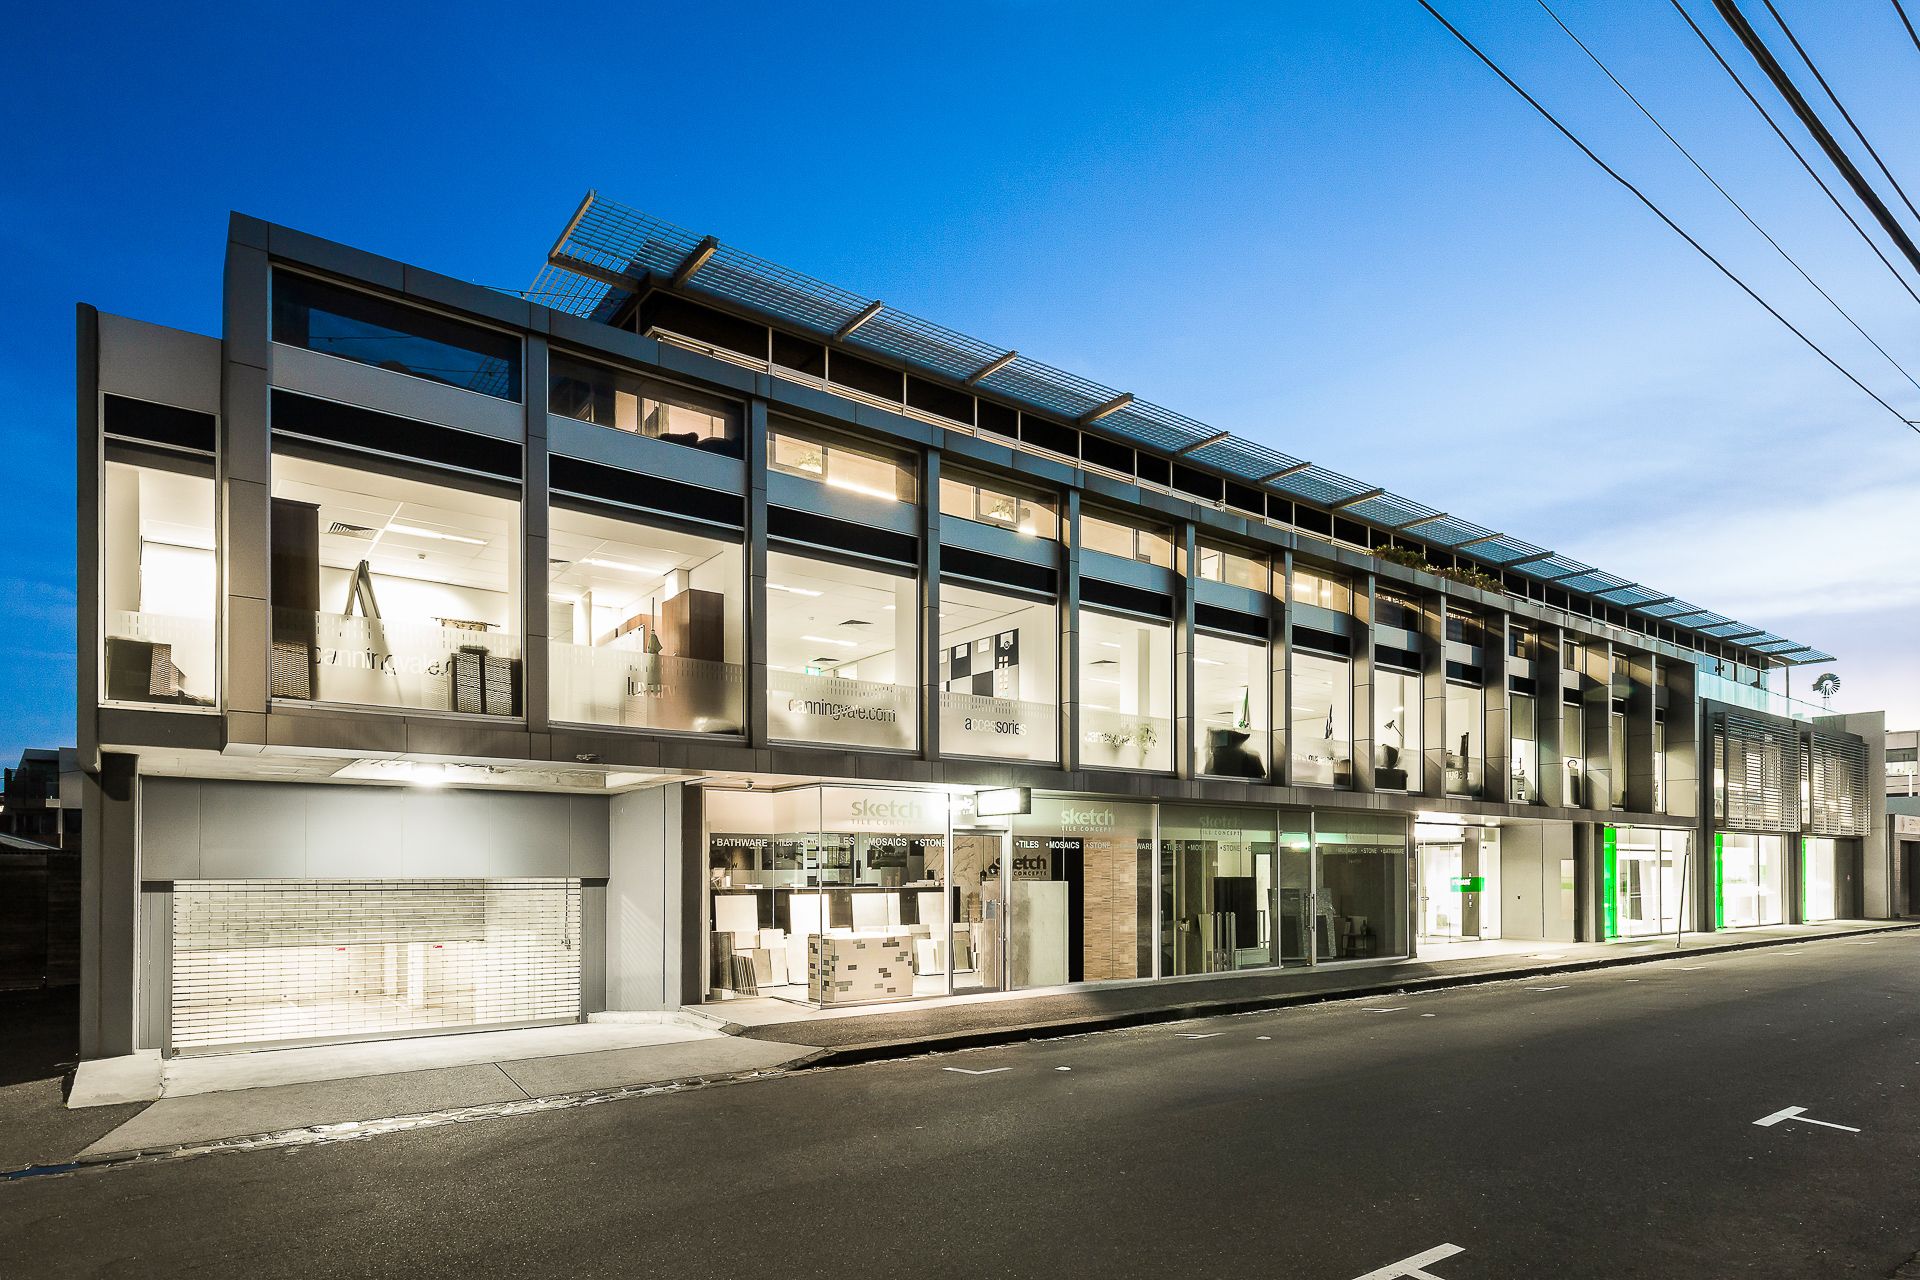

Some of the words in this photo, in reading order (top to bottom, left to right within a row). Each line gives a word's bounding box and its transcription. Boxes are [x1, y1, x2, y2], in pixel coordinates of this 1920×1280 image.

[788, 698, 896, 722] canningvale.com
[964, 717, 1028, 736] accessories
[851, 798, 924, 819] sketch
[1061, 808, 1115, 826] sketch
[716, 838, 768, 847] BATHWARE
[868, 837, 908, 847] MOSAICS
[1018, 840, 1039, 849] TILES
[1049, 840, 1080, 850] MOSAICS
